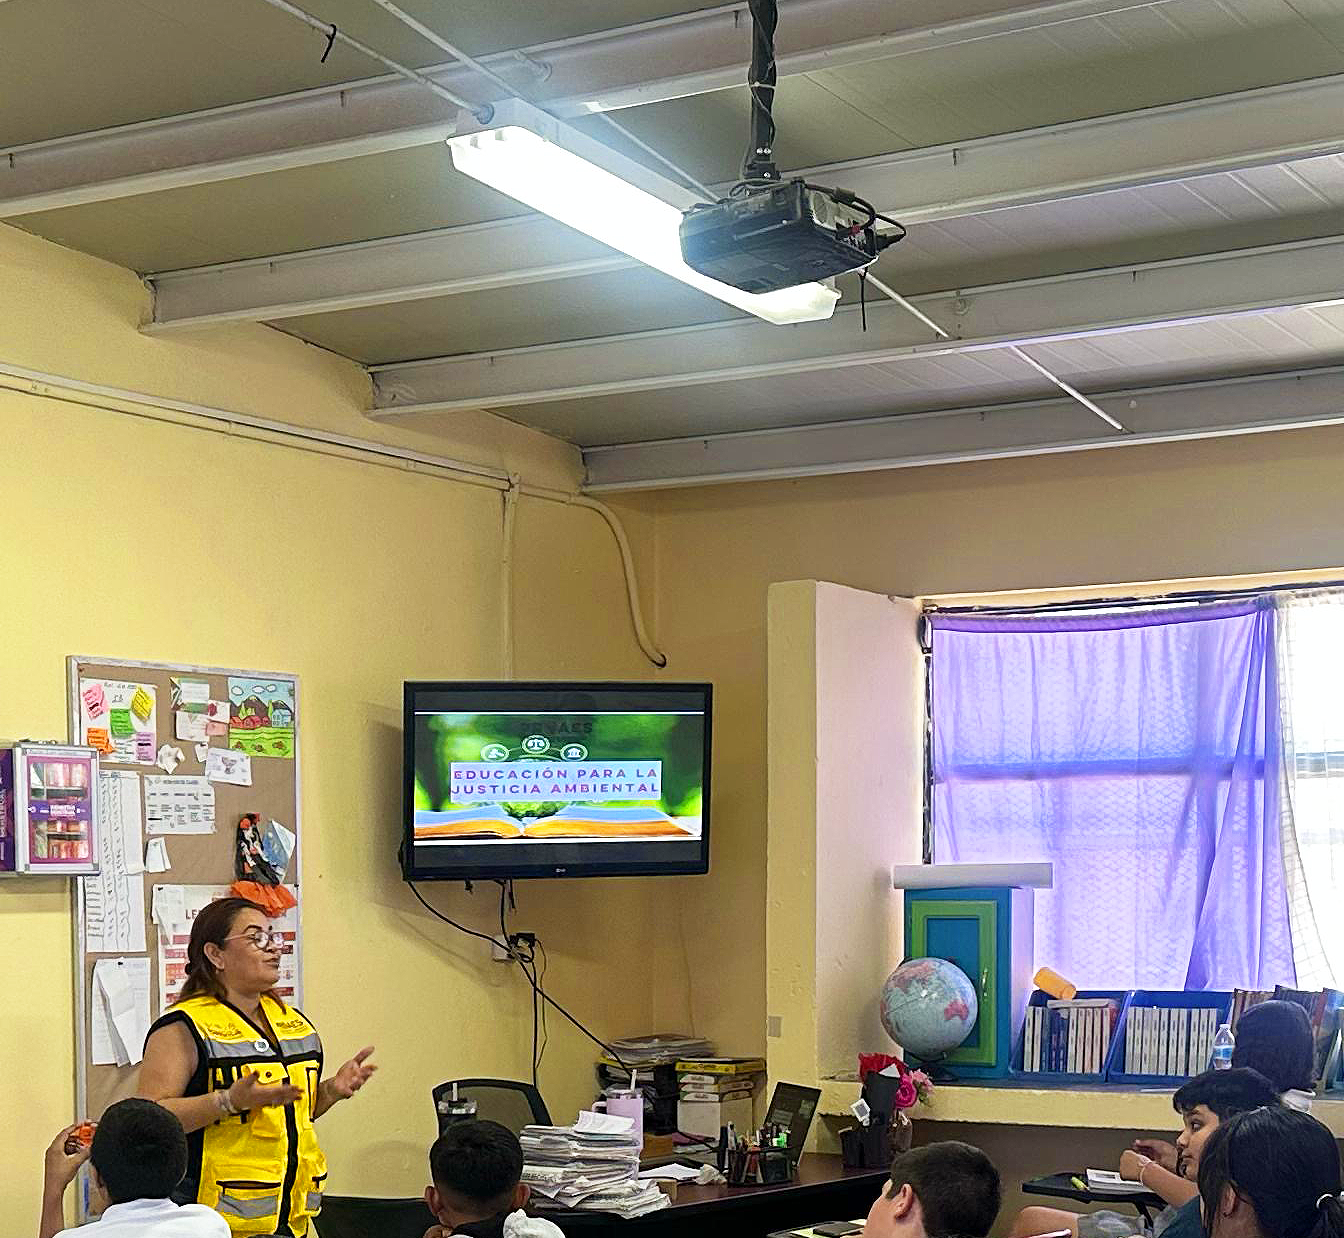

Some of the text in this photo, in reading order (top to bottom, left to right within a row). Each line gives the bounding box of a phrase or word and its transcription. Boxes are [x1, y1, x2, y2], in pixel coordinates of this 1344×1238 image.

[453, 767, 658, 780] EDUCACIÓN PARA LA
[451, 783, 659, 795] JUSTICIA AMBIENTAL
